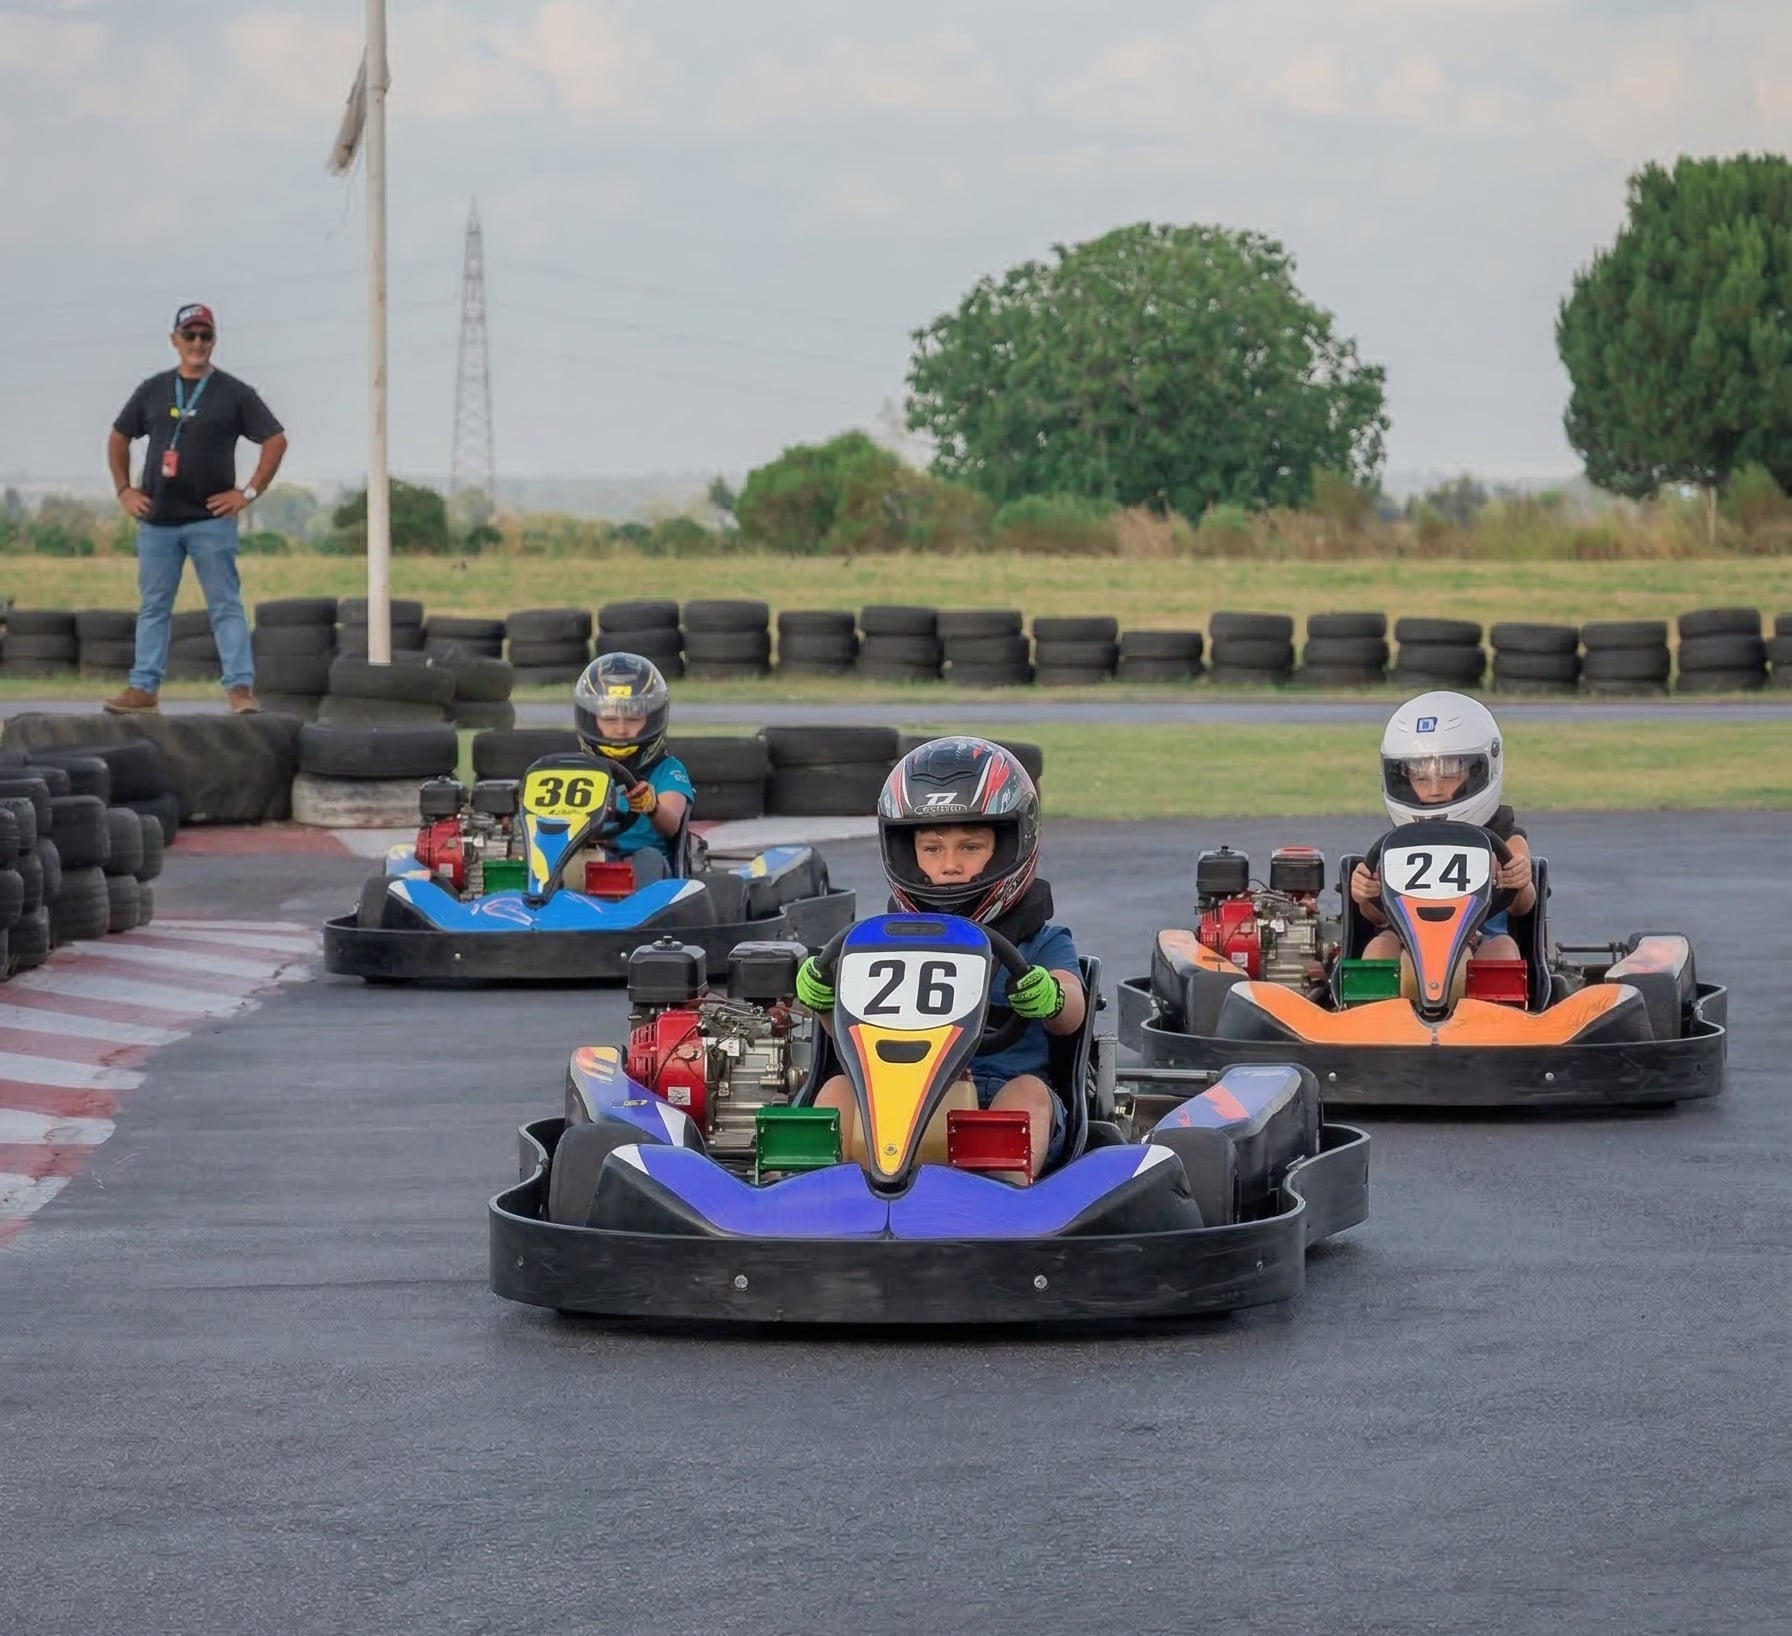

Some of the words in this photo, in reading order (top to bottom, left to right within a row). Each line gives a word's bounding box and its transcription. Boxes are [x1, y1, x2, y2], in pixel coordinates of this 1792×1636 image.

[535, 777, 594, 807] 36
[1404, 852, 1471, 891] 24
[863, 959, 957, 1016] 26
